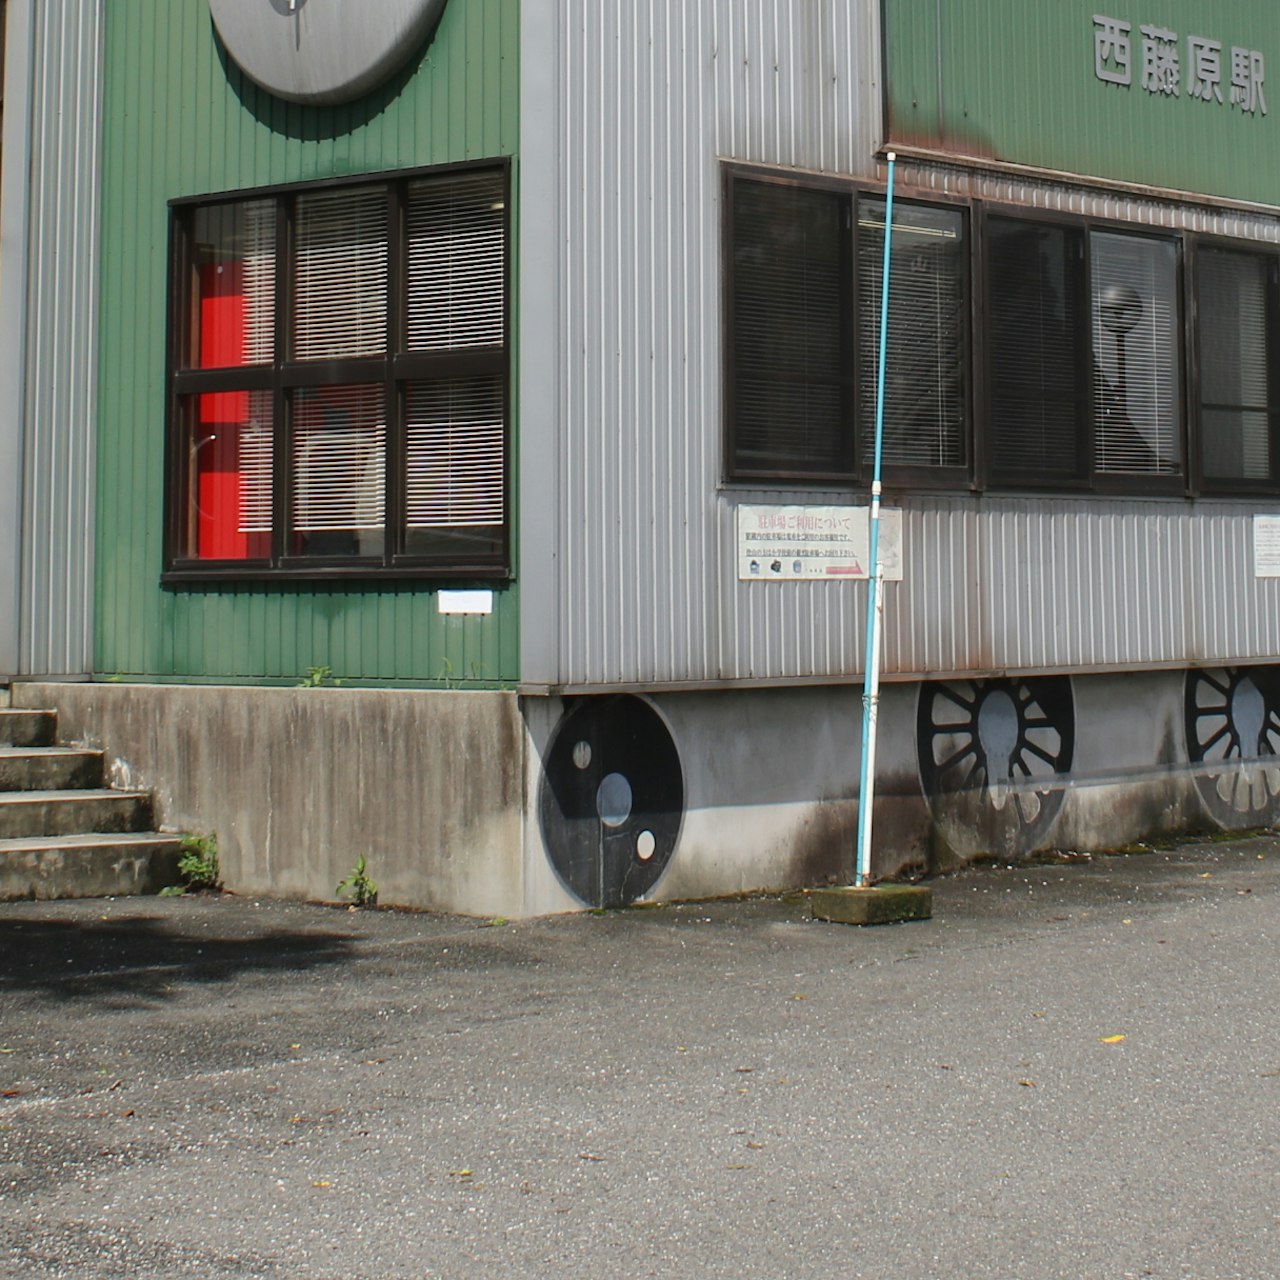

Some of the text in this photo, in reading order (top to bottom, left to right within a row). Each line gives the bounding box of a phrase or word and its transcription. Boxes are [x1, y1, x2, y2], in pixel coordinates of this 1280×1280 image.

[1092, 14, 1268, 116] 西藤原駅
[758, 515, 851, 530] 駐車場ご利用について
